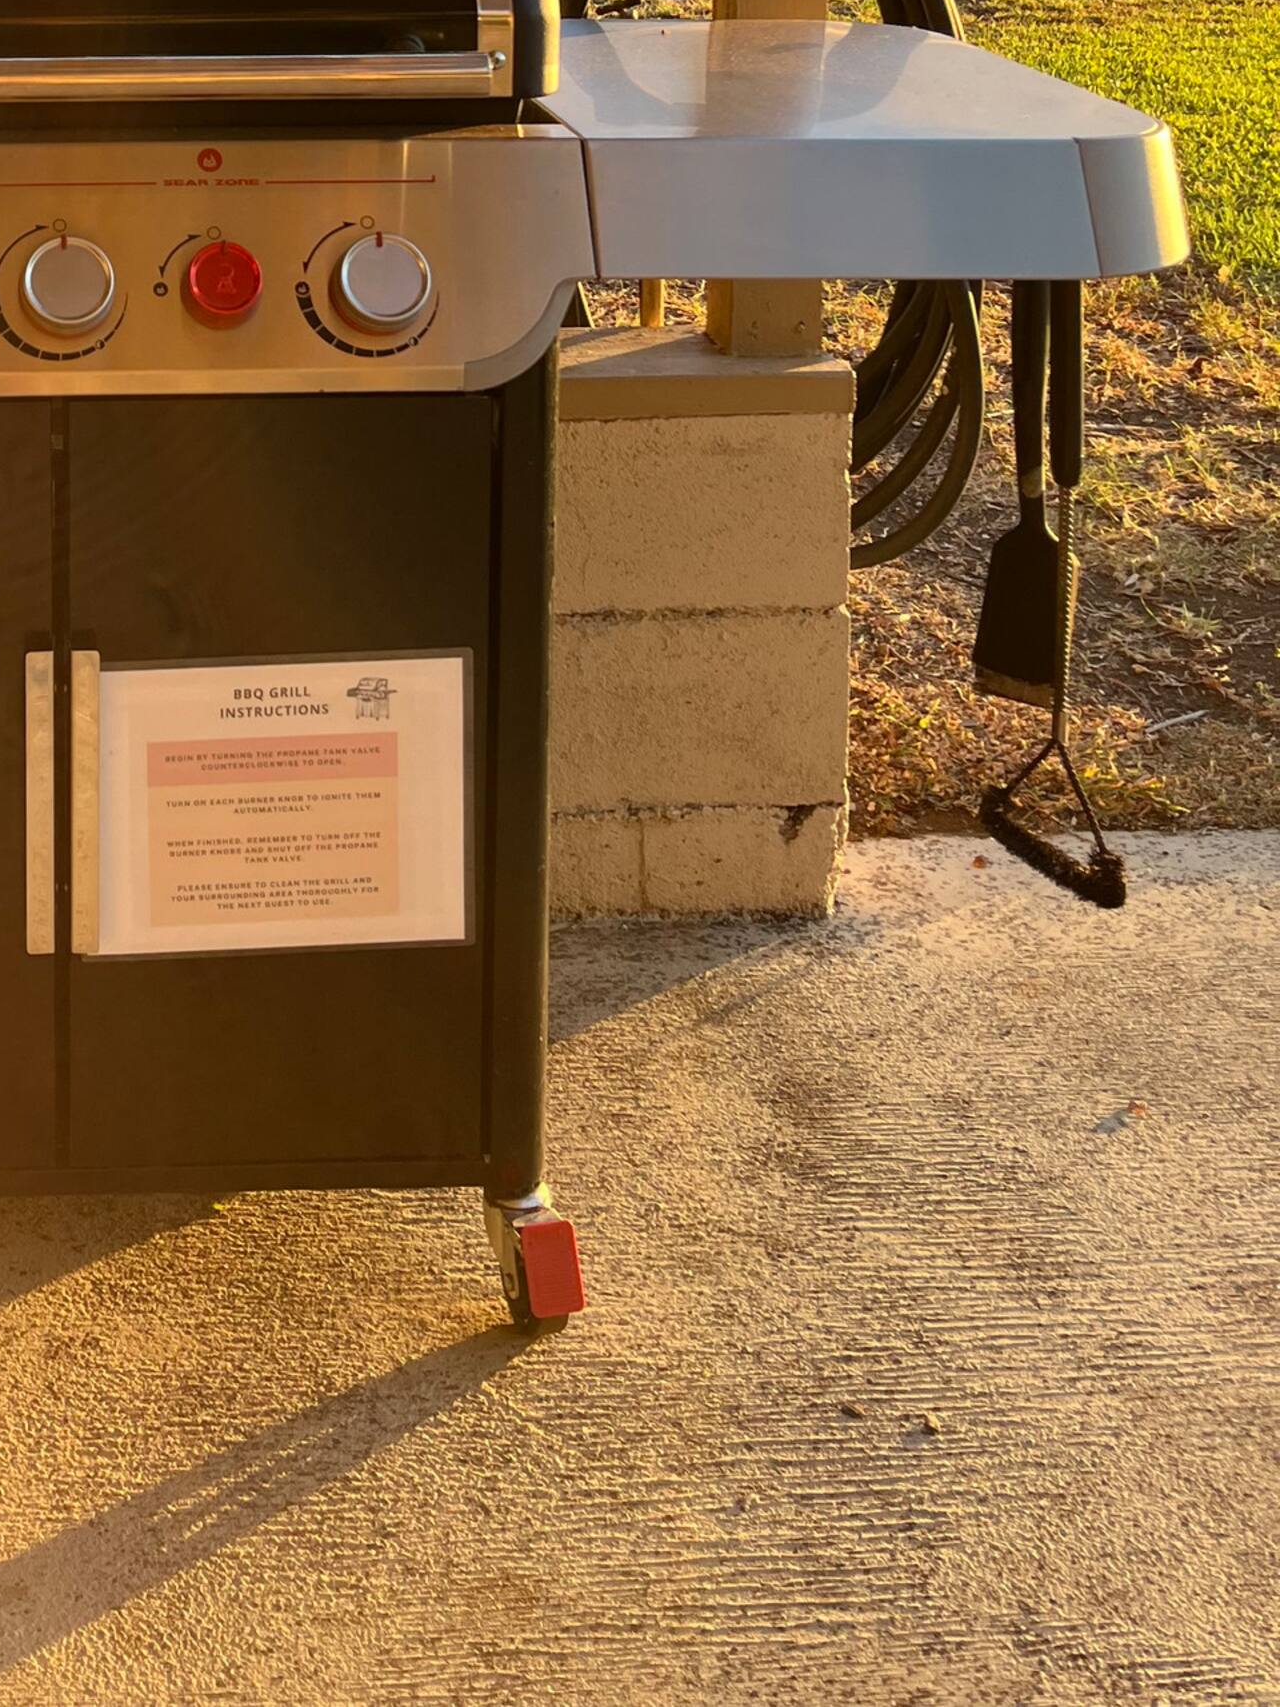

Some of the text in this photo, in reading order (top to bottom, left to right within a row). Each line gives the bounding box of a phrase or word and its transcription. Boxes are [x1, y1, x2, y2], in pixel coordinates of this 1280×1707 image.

[233, 685, 311, 702] BBQ GRILL
[219, 703, 330, 719] INSTRUCTIONS
[211, 752, 253, 760] TURNING
[256, 751, 274, 759] THE
[276, 750, 320, 758] PROPANE
[323, 748, 348, 756] TANK
[351, 746, 381, 755] VALVE
[302, 759, 315, 767] TO
[166, 800, 191, 808] TURN
[209, 798, 235, 806] EACH
[238, 796, 275, 805] BURNER
[278, 795, 304, 803] KNOB
[306, 794, 319, 802] TO
[321, 793, 352, 801] IGNITE
[167, 840, 194, 848] WHEN
[246, 836, 298, 845] REMEMBER
[316, 833, 341, 841] TURN
[343, 832, 361, 840] OFF
[363, 831, 381, 839] THE
[169, 842, 379, 857] BURNER KNOBS AND SHUT OFF THE PROPANE
[244, 856, 269, 864] TANK
[177, 884, 212, 892] PLEASE
[215, 882, 252, 890] ENSURE
[270, 880, 300, 888] CLEAN
[303, 879, 321, 887] THE
[323, 878, 350, 886] GRILL
[353, 876, 372, 884] AND
[170, 886, 379, 902] YOUR SURROUNDING AREA THOROUGHLY FOR
[217, 902, 234, 910] THE
[237, 901, 262, 909] NEXT
[297, 899, 310, 907] TO
